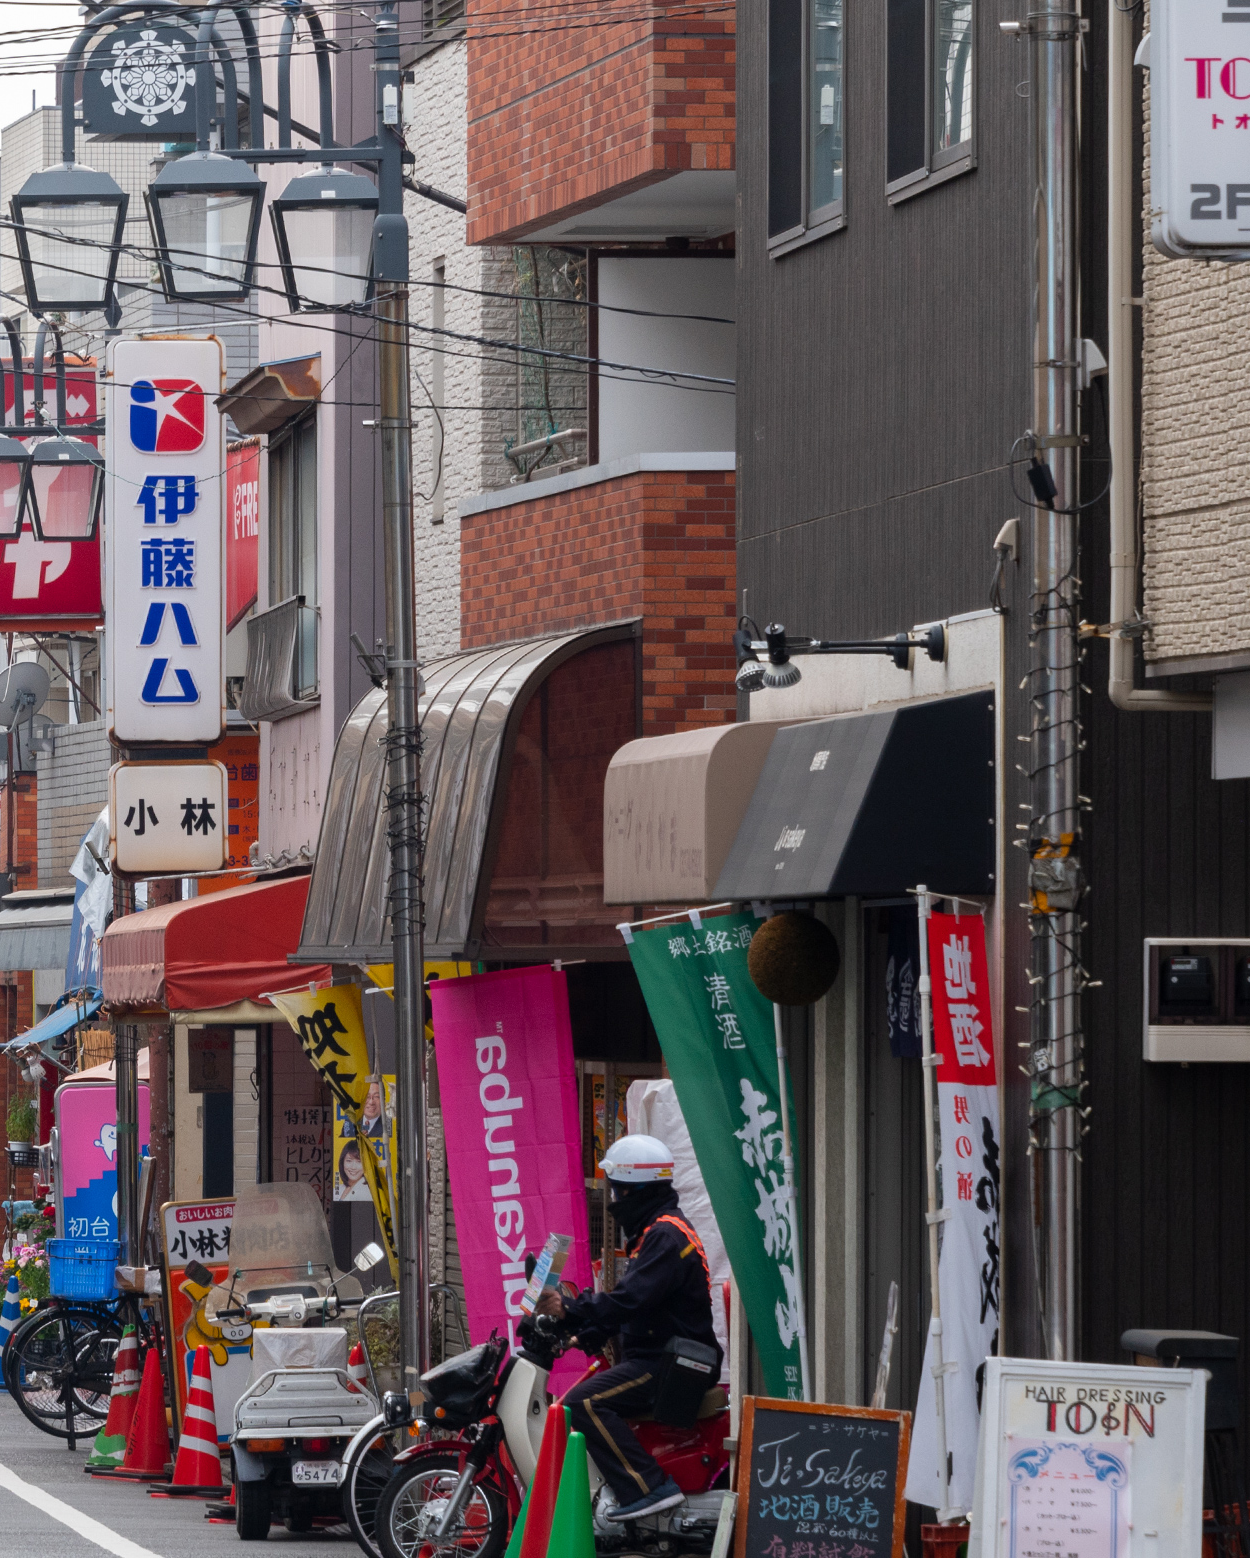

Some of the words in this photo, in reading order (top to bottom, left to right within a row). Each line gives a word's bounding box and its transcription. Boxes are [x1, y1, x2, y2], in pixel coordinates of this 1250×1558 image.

[134, 474, 201, 704] 伊藤ハム
[124, 797, 217, 836] 小林
[668, 926, 754, 959] 郷土銘酒
[703, 972, 746, 1050] 清酒
[68, 1216, 110, 1238] 初台
[178, 1206, 233, 1222] おいしいお肉
[1025, 1385, 1066, 1400] HAIR
[1076, 1387, 1167, 1405] DRESSING
[304, 1468, 339, 1481] 5474
[1039, 1471, 1096, 1480] メニュー
[759, 1494, 880, 1529] 地酒販売
